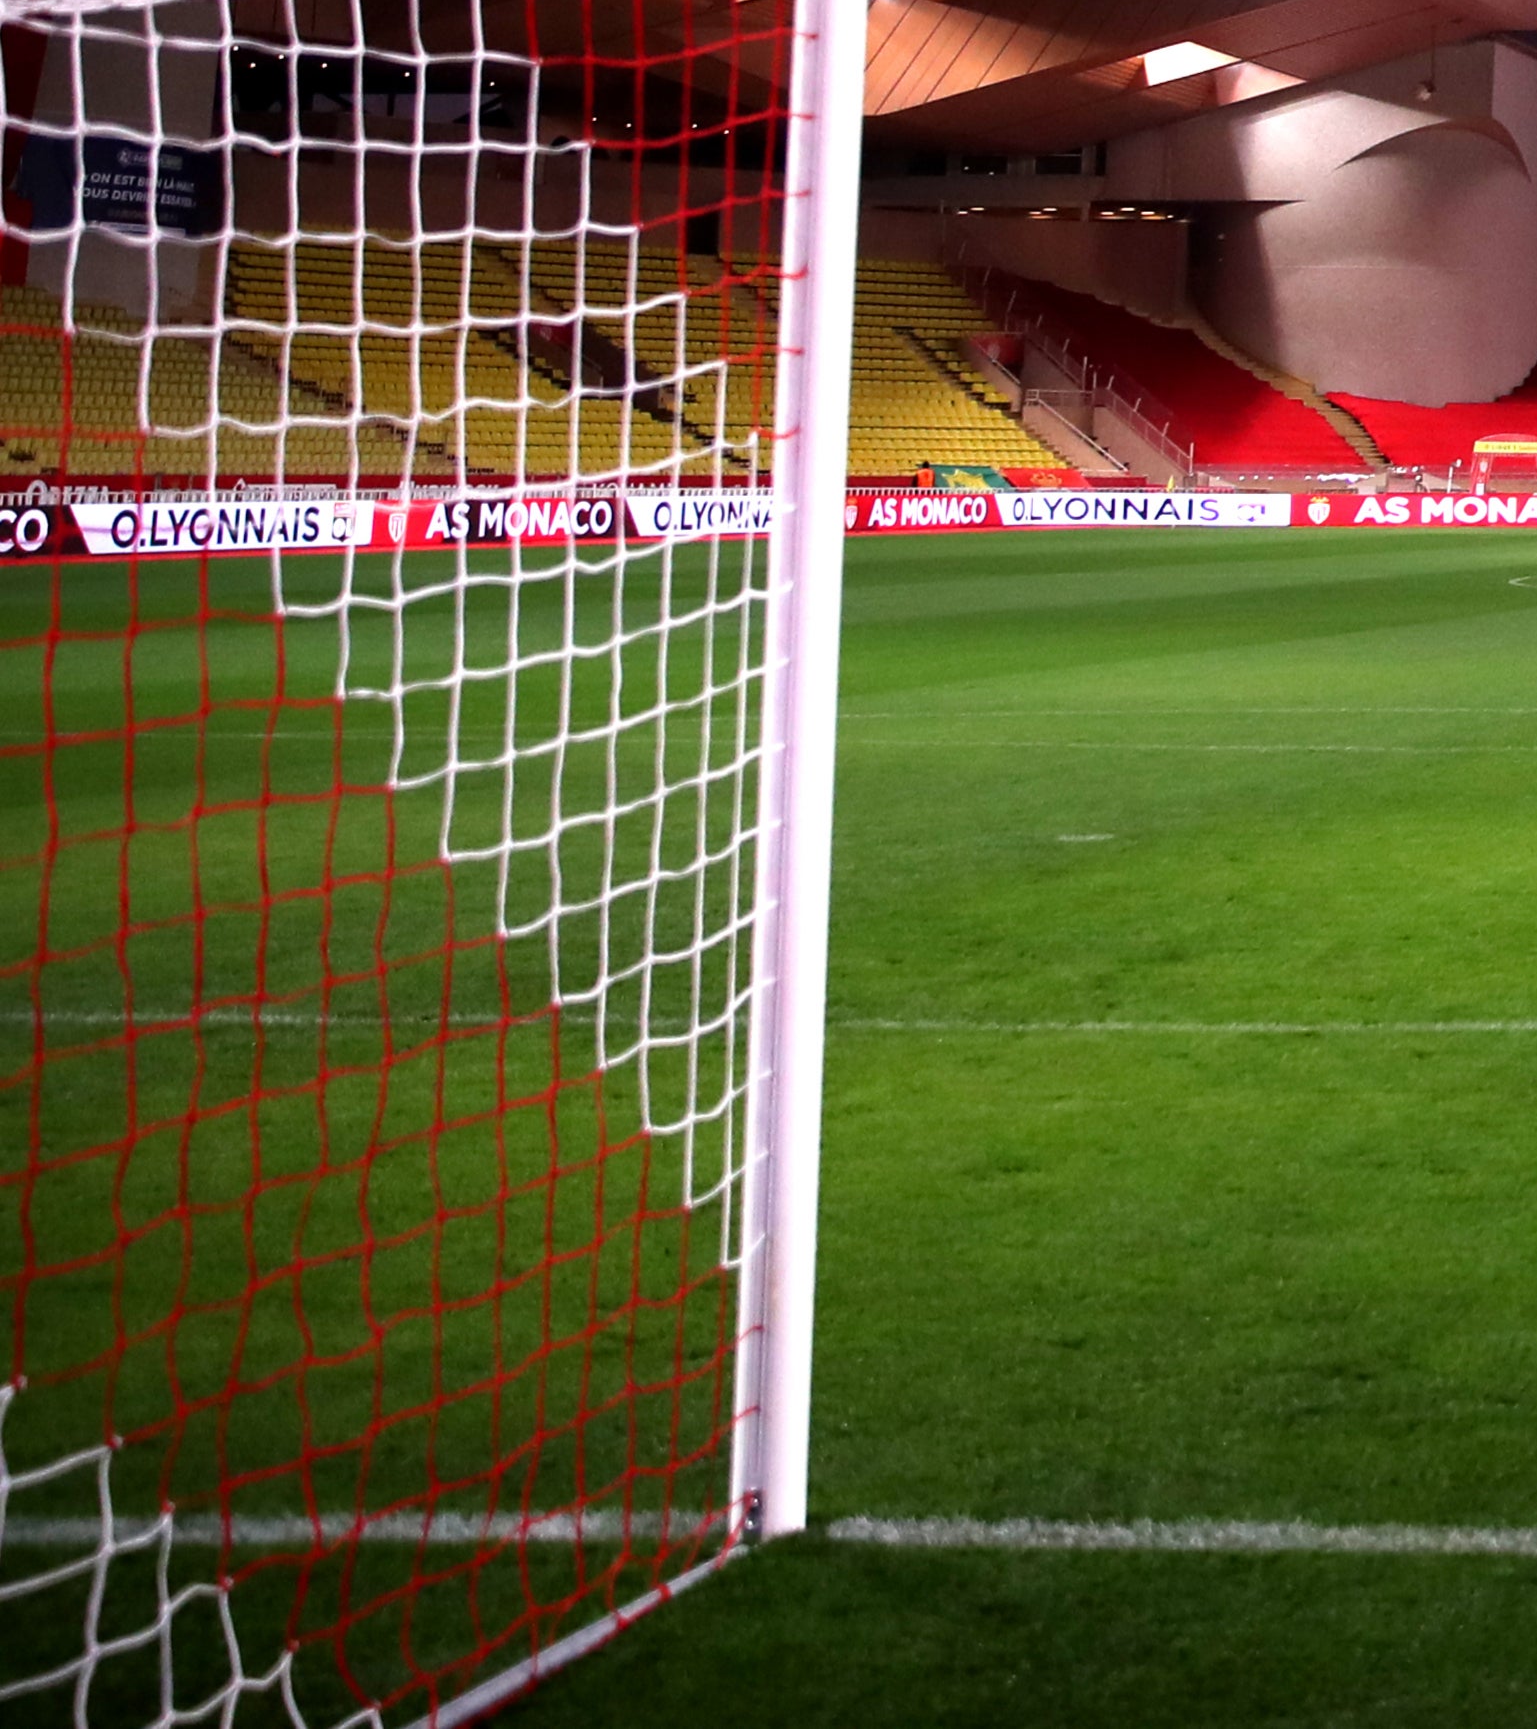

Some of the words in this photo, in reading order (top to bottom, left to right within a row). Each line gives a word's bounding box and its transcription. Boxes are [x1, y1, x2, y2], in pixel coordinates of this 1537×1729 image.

[425, 501, 471, 540] AS
[478, 500, 613, 538] MONACO
[867, 497, 897, 527] AS
[901, 496, 988, 526] MONACO
[1013, 497, 1220, 522] O.LYONNAIS
[1353, 496, 1411, 524] AS
